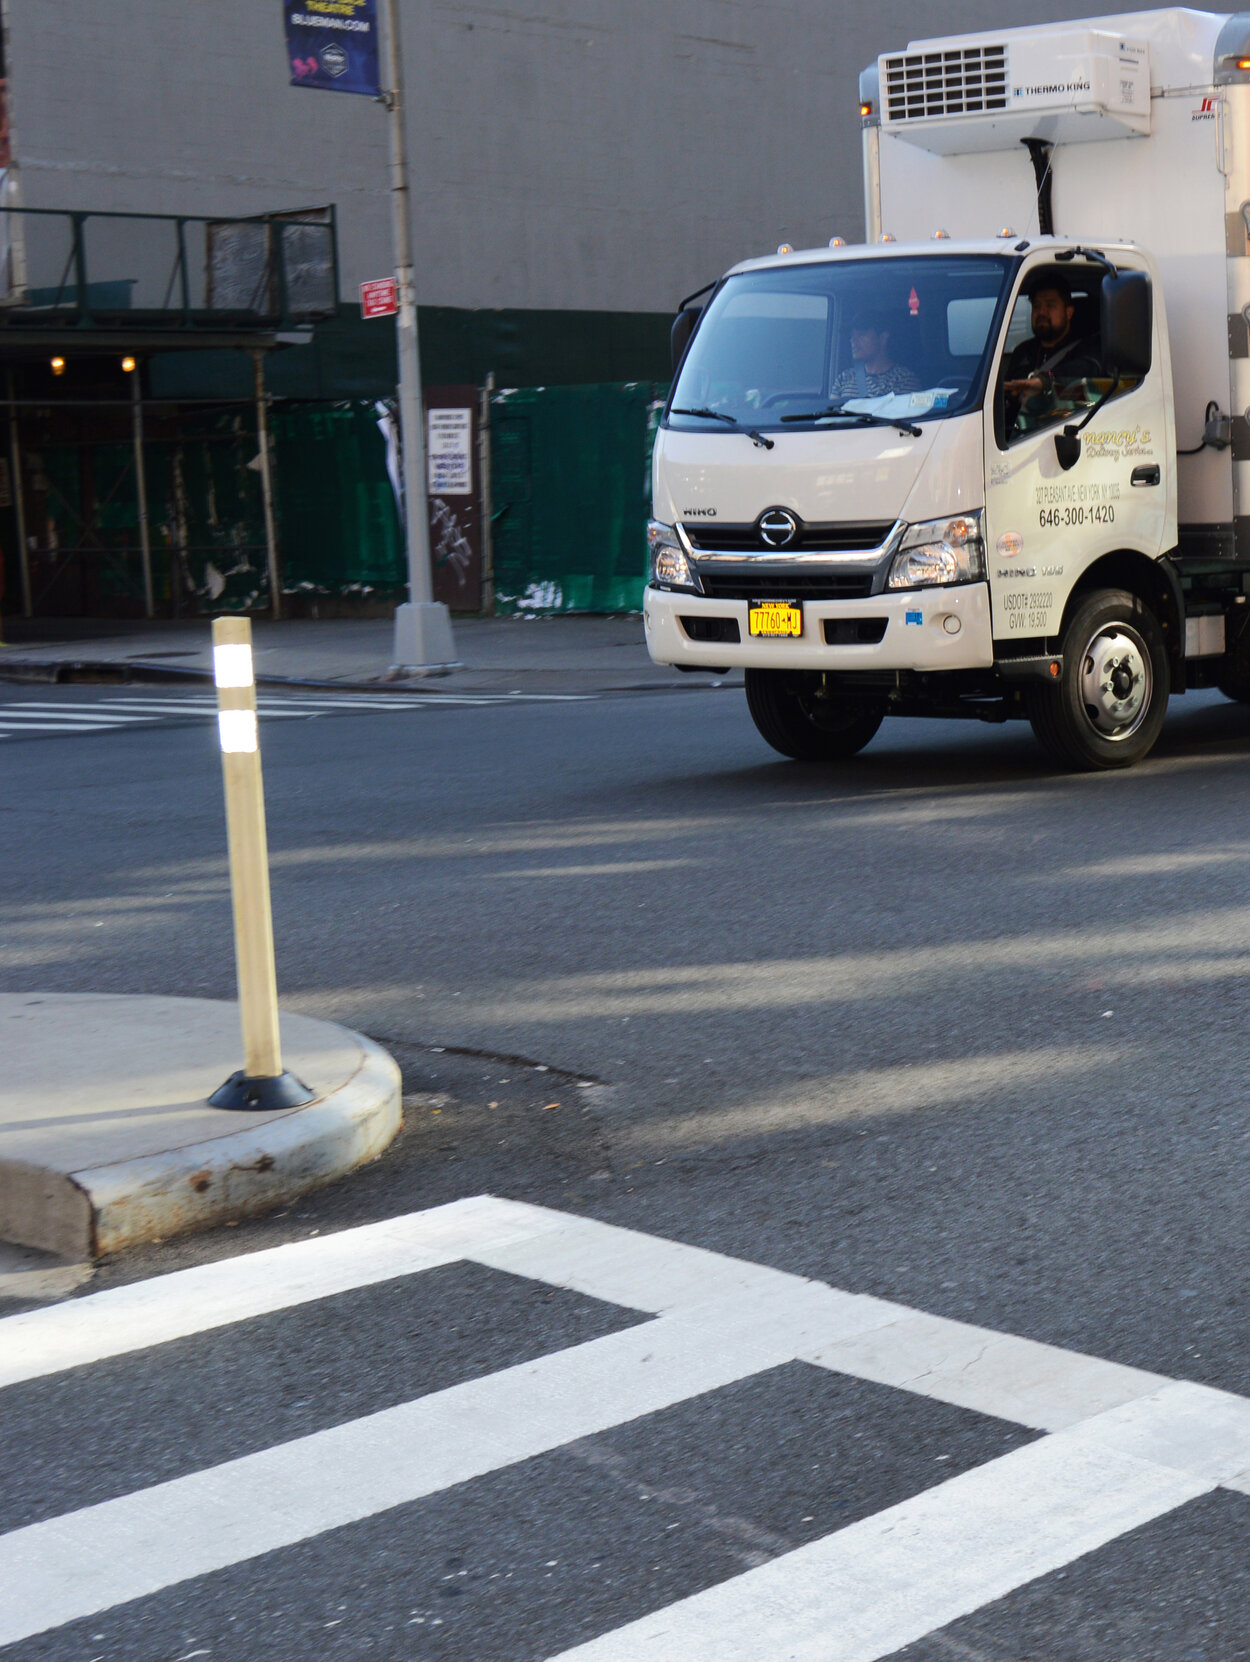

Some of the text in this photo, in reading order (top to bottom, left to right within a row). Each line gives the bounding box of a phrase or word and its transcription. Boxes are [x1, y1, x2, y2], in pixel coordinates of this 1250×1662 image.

[291, 13, 371, 33] BLUEMAN.COM
[1025, 81, 1091, 97] THERMO KING
[1044, 485, 1067, 504] PLEASANT
[1077, 483, 1088, 502] NEW
[1088, 483, 1101, 502] YORK
[683, 507, 718, 517] HINO
[1039, 504, 1115, 527] 646-300-1420
[996, 566, 1038, 578] HINO
[1004, 593, 1029, 611] USDOT#
